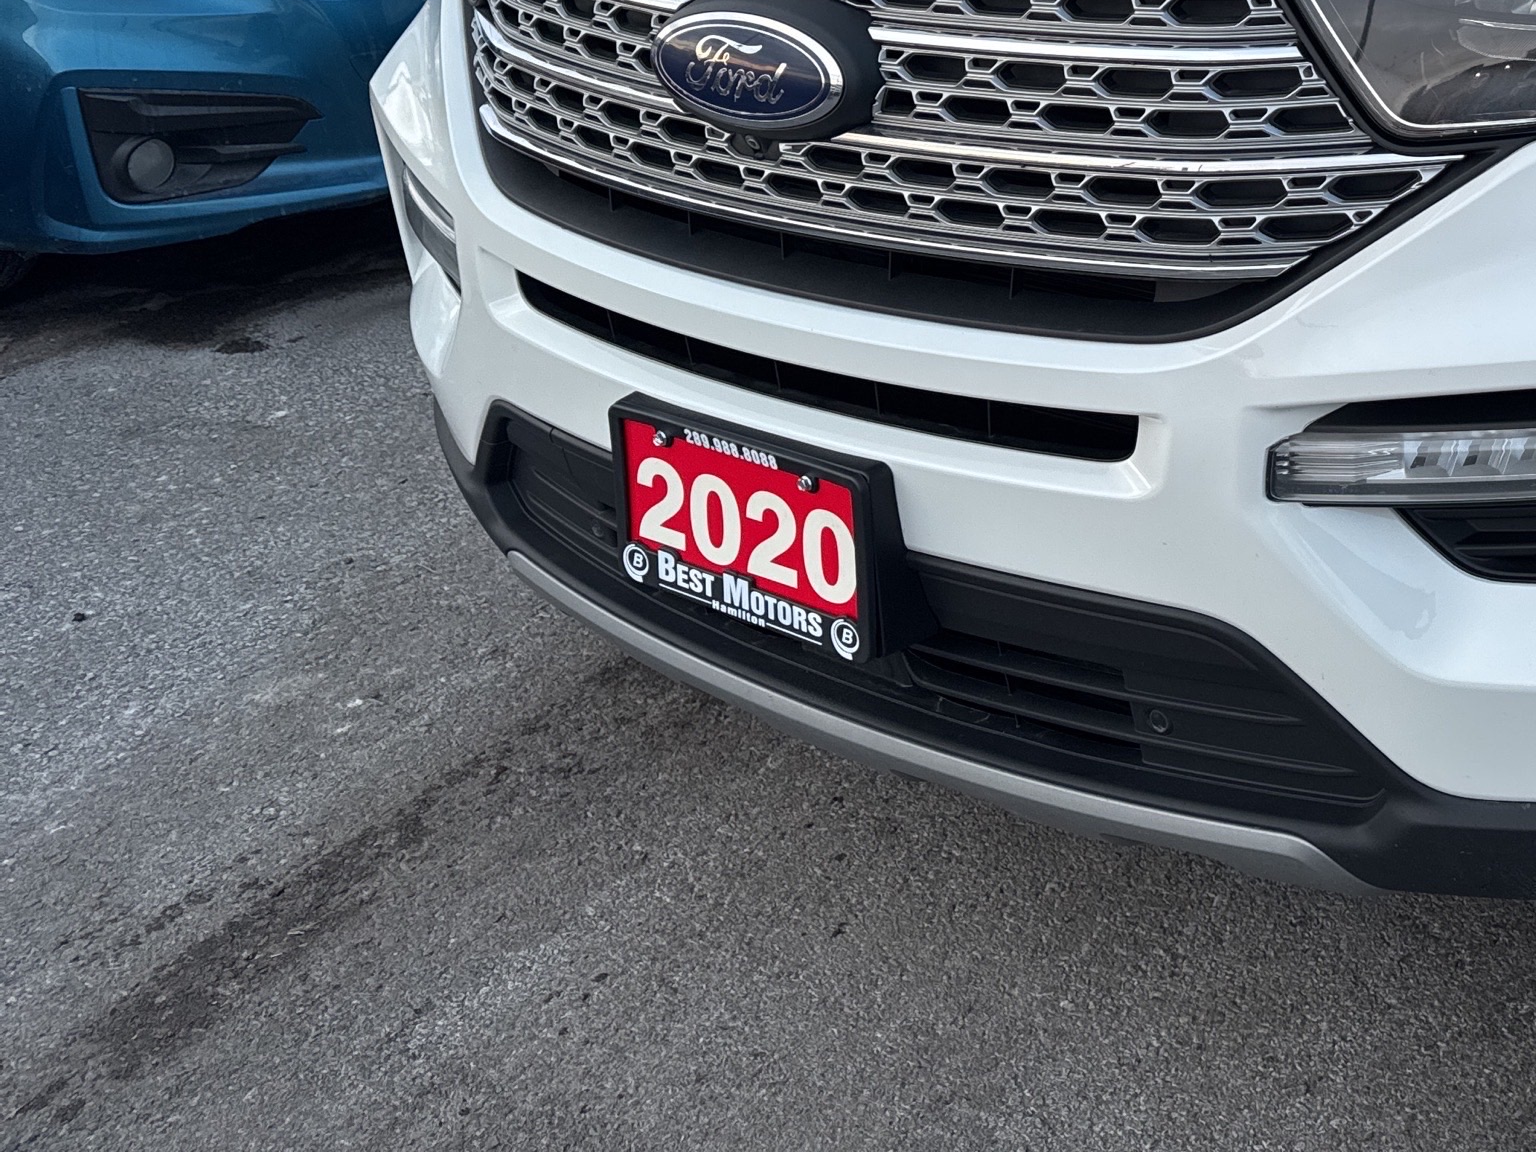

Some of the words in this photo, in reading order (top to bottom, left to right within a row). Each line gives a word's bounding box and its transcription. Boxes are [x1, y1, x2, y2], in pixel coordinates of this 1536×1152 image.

[684, 34, 789, 104] Ford
[683, 428, 778, 470] 289.988.8088
[636, 456, 858, 605] 2020
[657, 549, 715, 598] BEST
[722, 572, 823, 638] MOTORS
[711, 599, 766, 628] Hamilton
